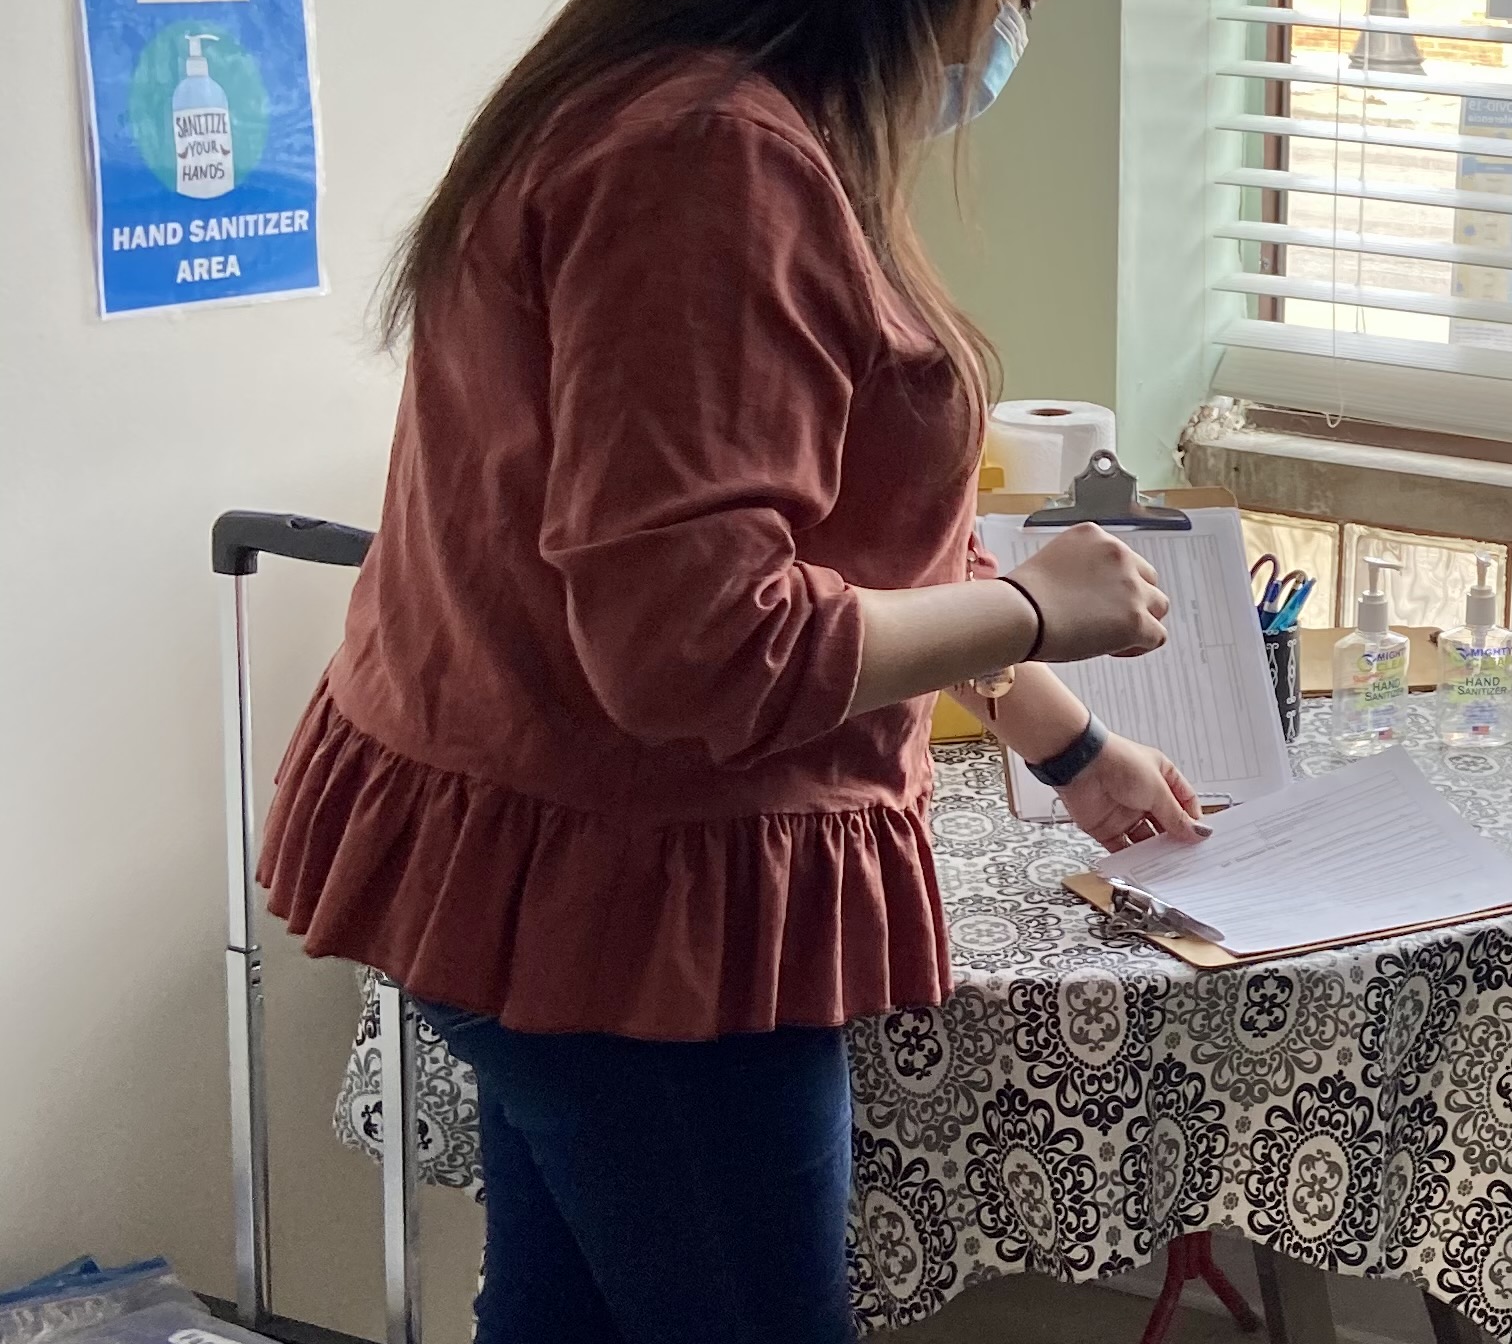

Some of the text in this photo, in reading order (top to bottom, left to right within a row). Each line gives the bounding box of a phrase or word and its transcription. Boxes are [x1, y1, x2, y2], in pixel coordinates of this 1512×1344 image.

[176, 112, 228, 138] SANITIZE
[187, 139, 218, 155] YOUR
[182, 162, 225, 182] HANDS
[112, 209, 310, 252] HAND SANITIZER
[176, 255, 241, 284] AREA
[1469, 646, 1512, 657] MIGHTY
[1372, 680, 1401, 692] HAND
[1465, 676, 1500, 687] HAND
[1457, 686, 1507, 696] SANITIZER
